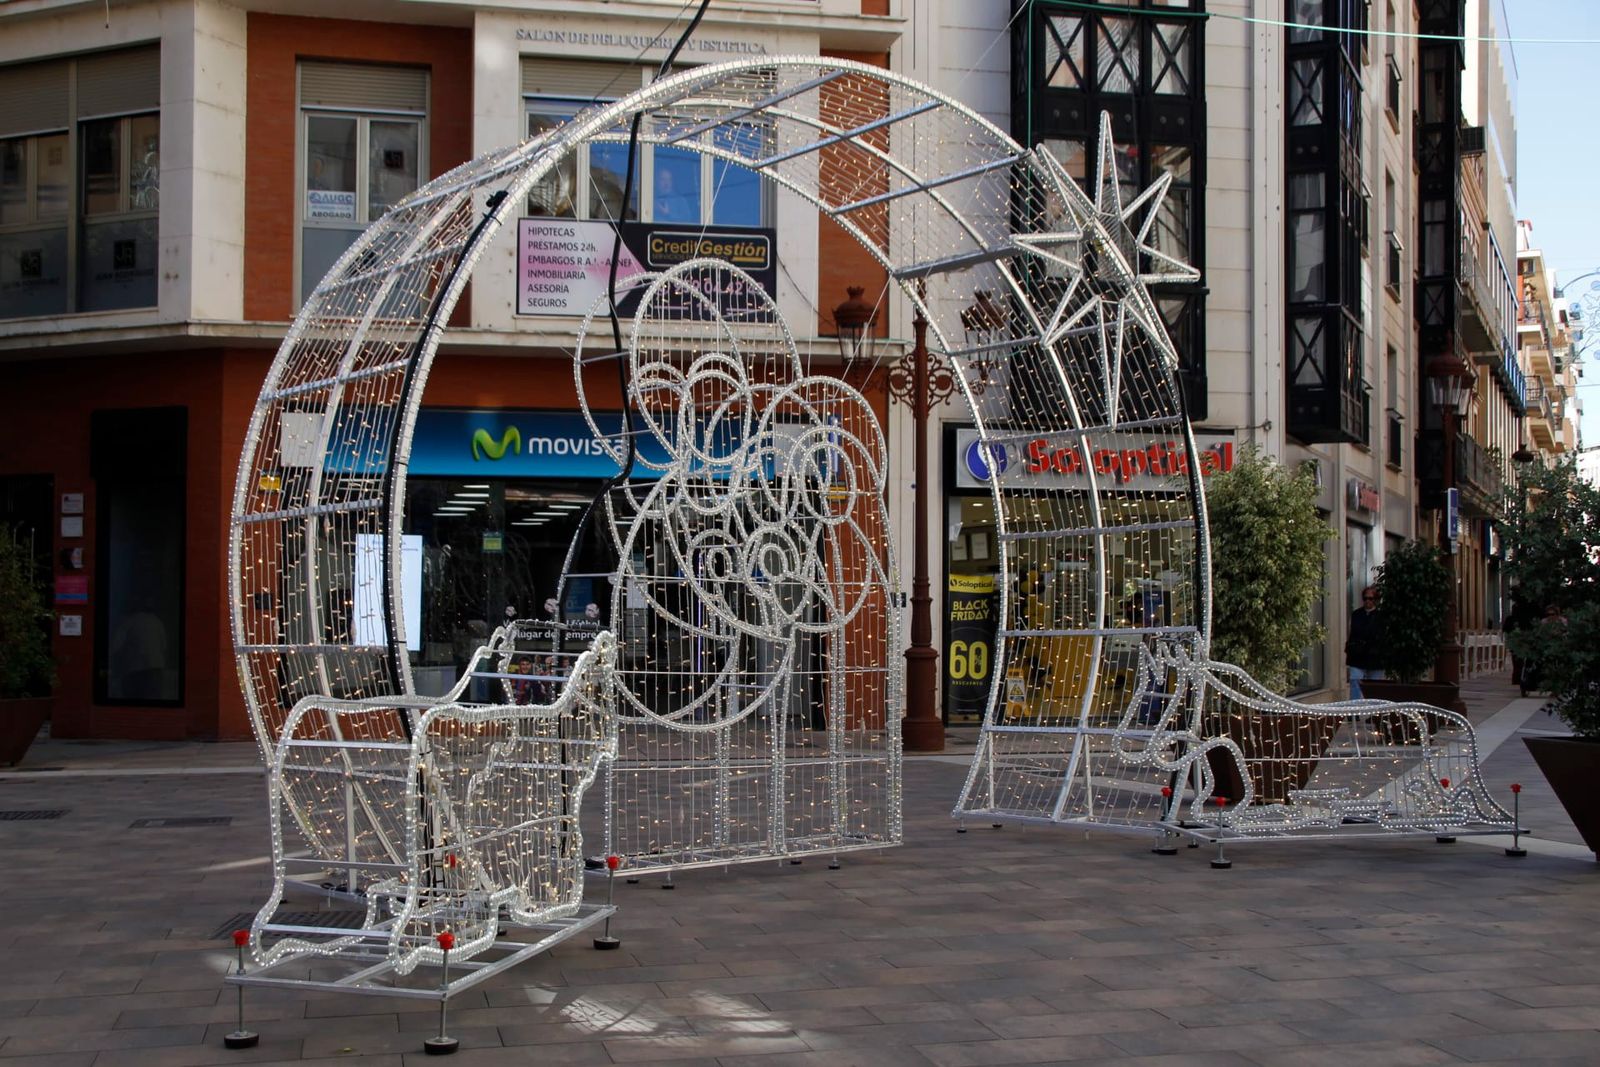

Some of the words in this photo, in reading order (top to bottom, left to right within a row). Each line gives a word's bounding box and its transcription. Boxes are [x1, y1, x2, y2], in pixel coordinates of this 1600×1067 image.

[569, 32, 589, 45] DE
[592, 33, 673, 50] PELUQUERI
[699, 39, 768, 55] ESTETICA
[528, 227, 575, 237] HIPOTECAS
[528, 239, 578, 252] PRÉSTAMOS
[652, 238, 766, 257] CreditGestión
[528, 255, 576, 266] EMBARGOS
[605, 258, 632, 268] ANEF
[528, 269, 586, 280] INMOBILIARIA
[528, 283, 569, 294] ASESORÍA
[528, 298, 567, 308] SEGUROS
[529, 437, 635, 455] movista
[958, 581, 993, 589] Soloptical
[953, 600, 988, 610] BLACK
[951, 609, 990, 621] FRIDAY
[517, 630, 543, 640] lugar
[950, 640, 988, 680] 60
